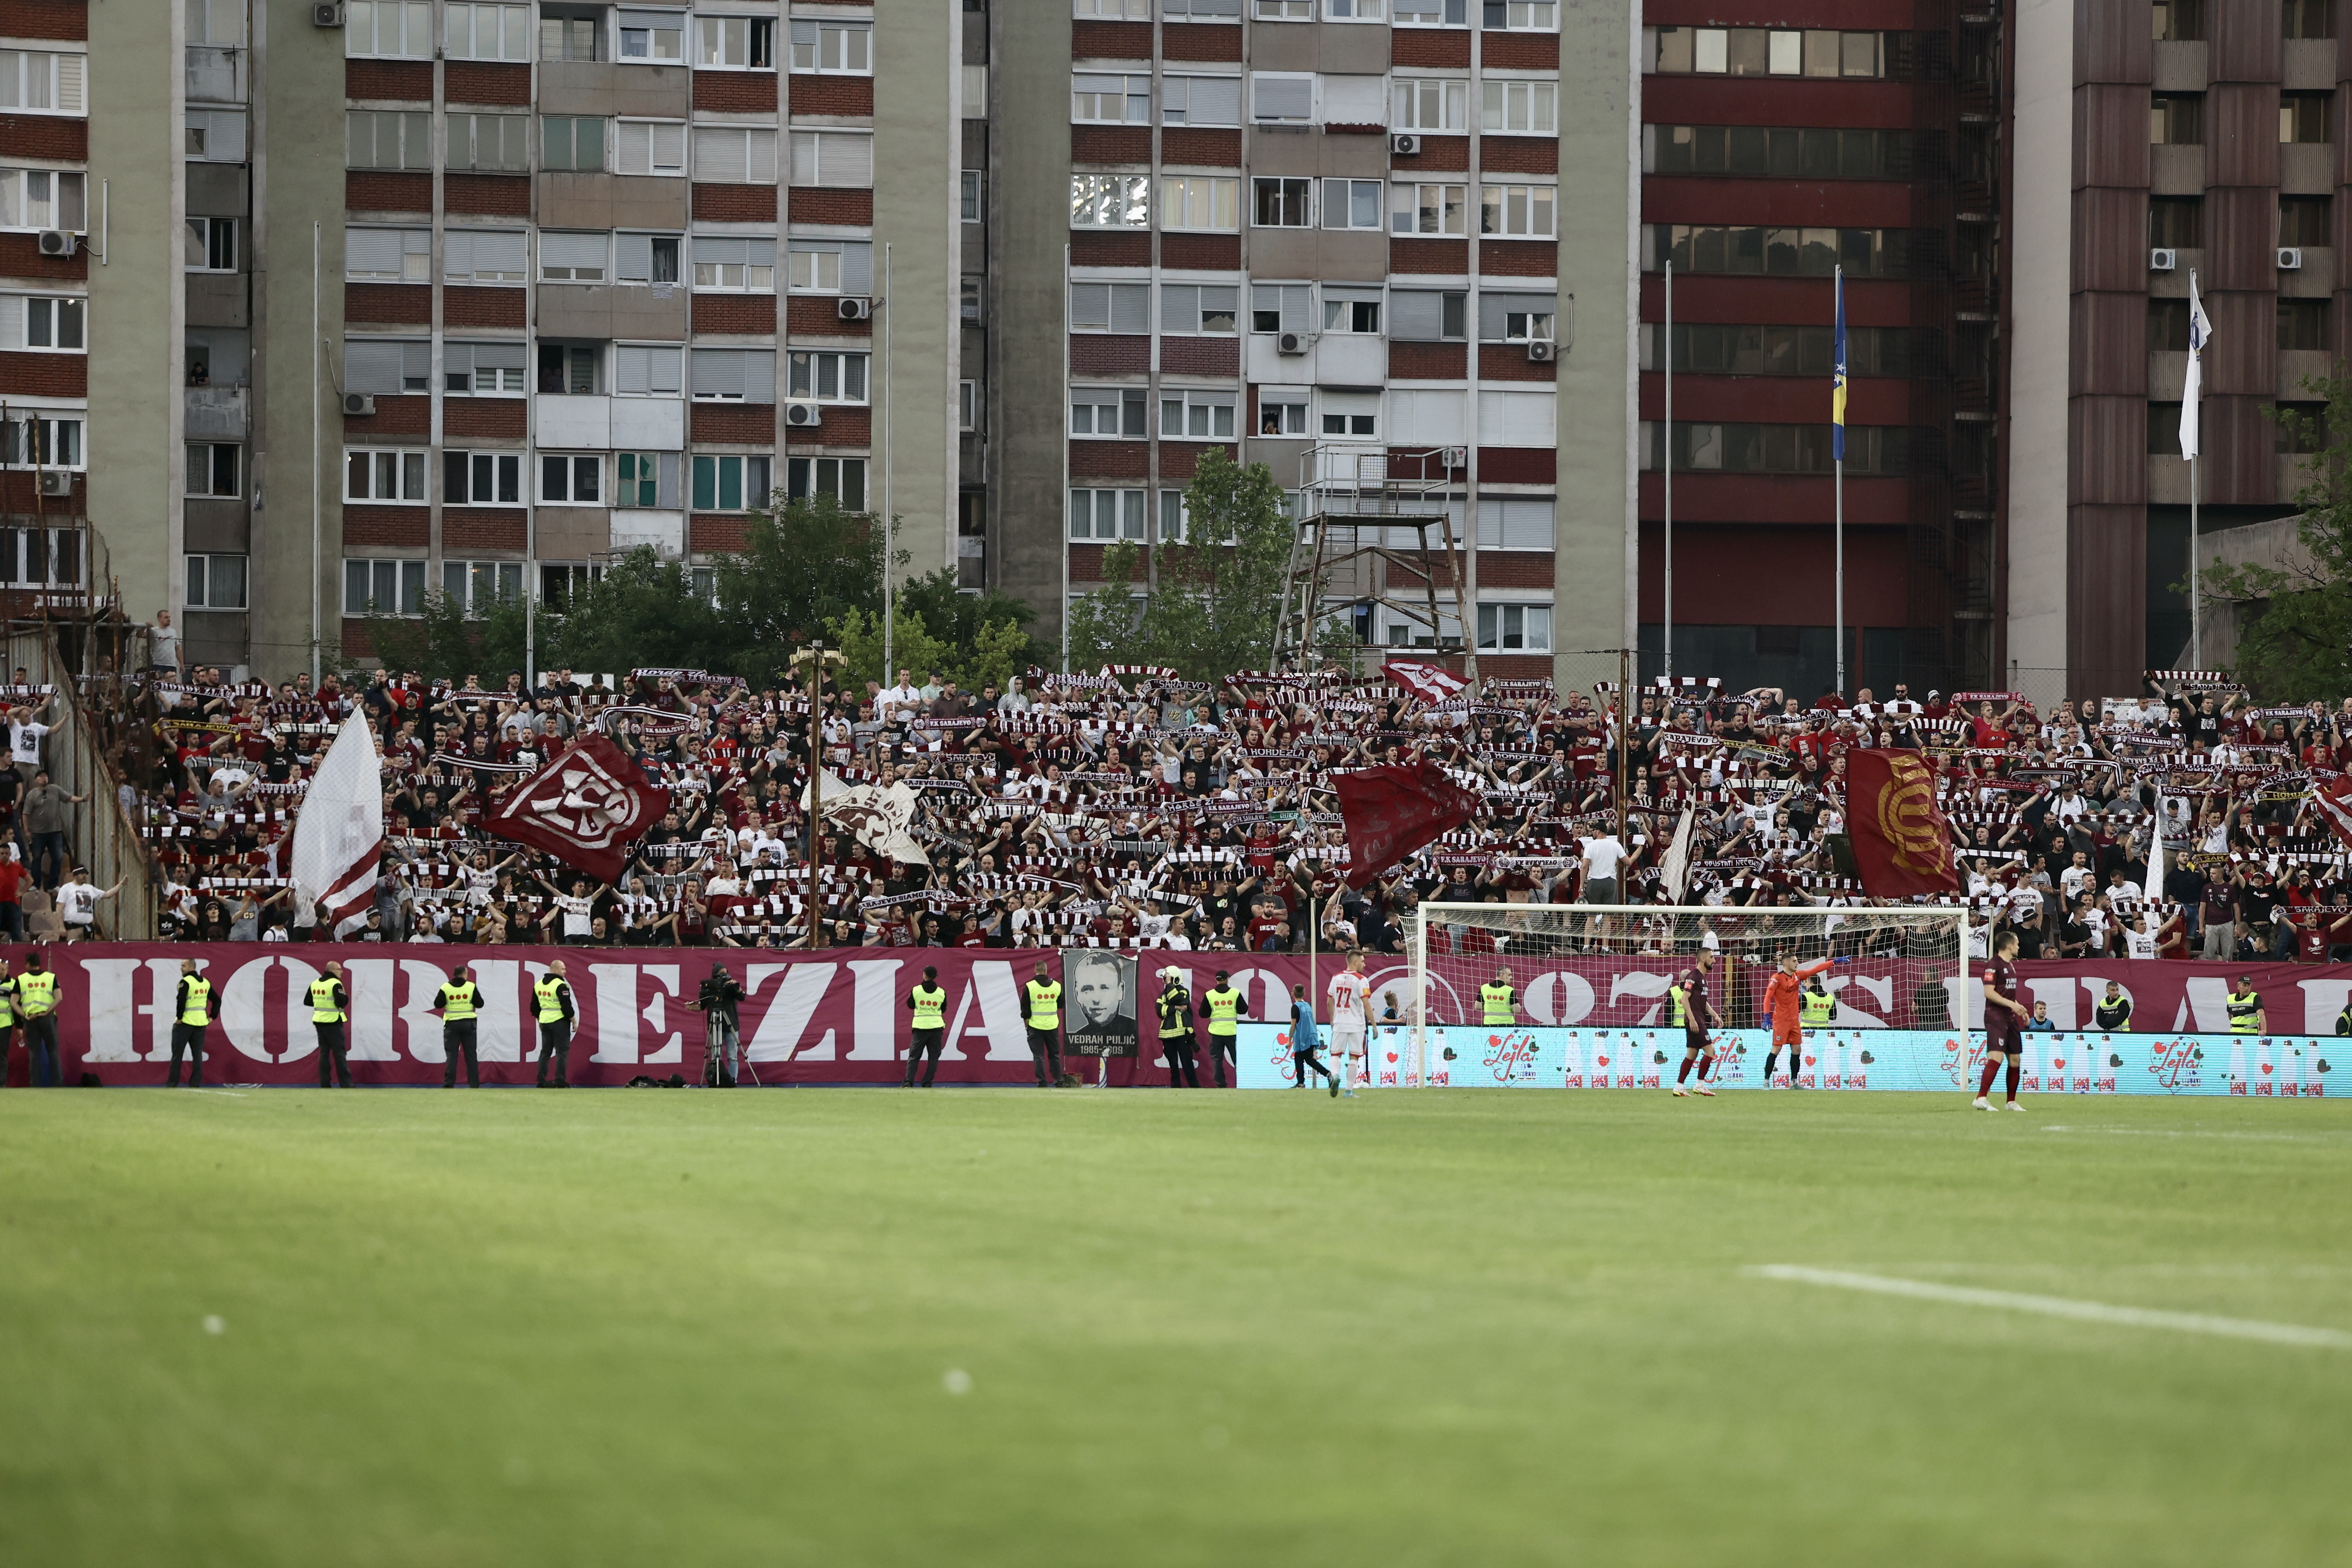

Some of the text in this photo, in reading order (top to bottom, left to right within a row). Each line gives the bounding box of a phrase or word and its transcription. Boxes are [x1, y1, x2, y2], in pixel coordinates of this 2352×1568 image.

[699, 676, 732, 684] SARAJEVO
[1068, 676, 1104, 687] SARAJEVO
[1159, 680, 1205, 689] SARAJEVO
[1335, 700, 1374, 712] SARAJEVO
[1786, 709, 1827, 723] SARAJEVO
[172, 721, 231, 730] SARAJEVO
[655, 725, 686, 734] SARAJEVO
[2099, 727, 2159, 736] SARAJEVO
[1665, 733, 1709, 743] SARAJEVO
[2227, 765, 2275, 773] SARAJEVO
[1250, 778, 1292, 787] SARAJEVO
[898, 893, 924, 902] SIAMO
[1336, 986, 1352, 1008] 77
[80, 958, 683, 1063] HORDE
[1068, 1033, 1136, 1045] VEDRAN PULJIĆ
[1483, 1034, 1535, 1081] Lejla
[2148, 1041, 2200, 1088] Lejla
